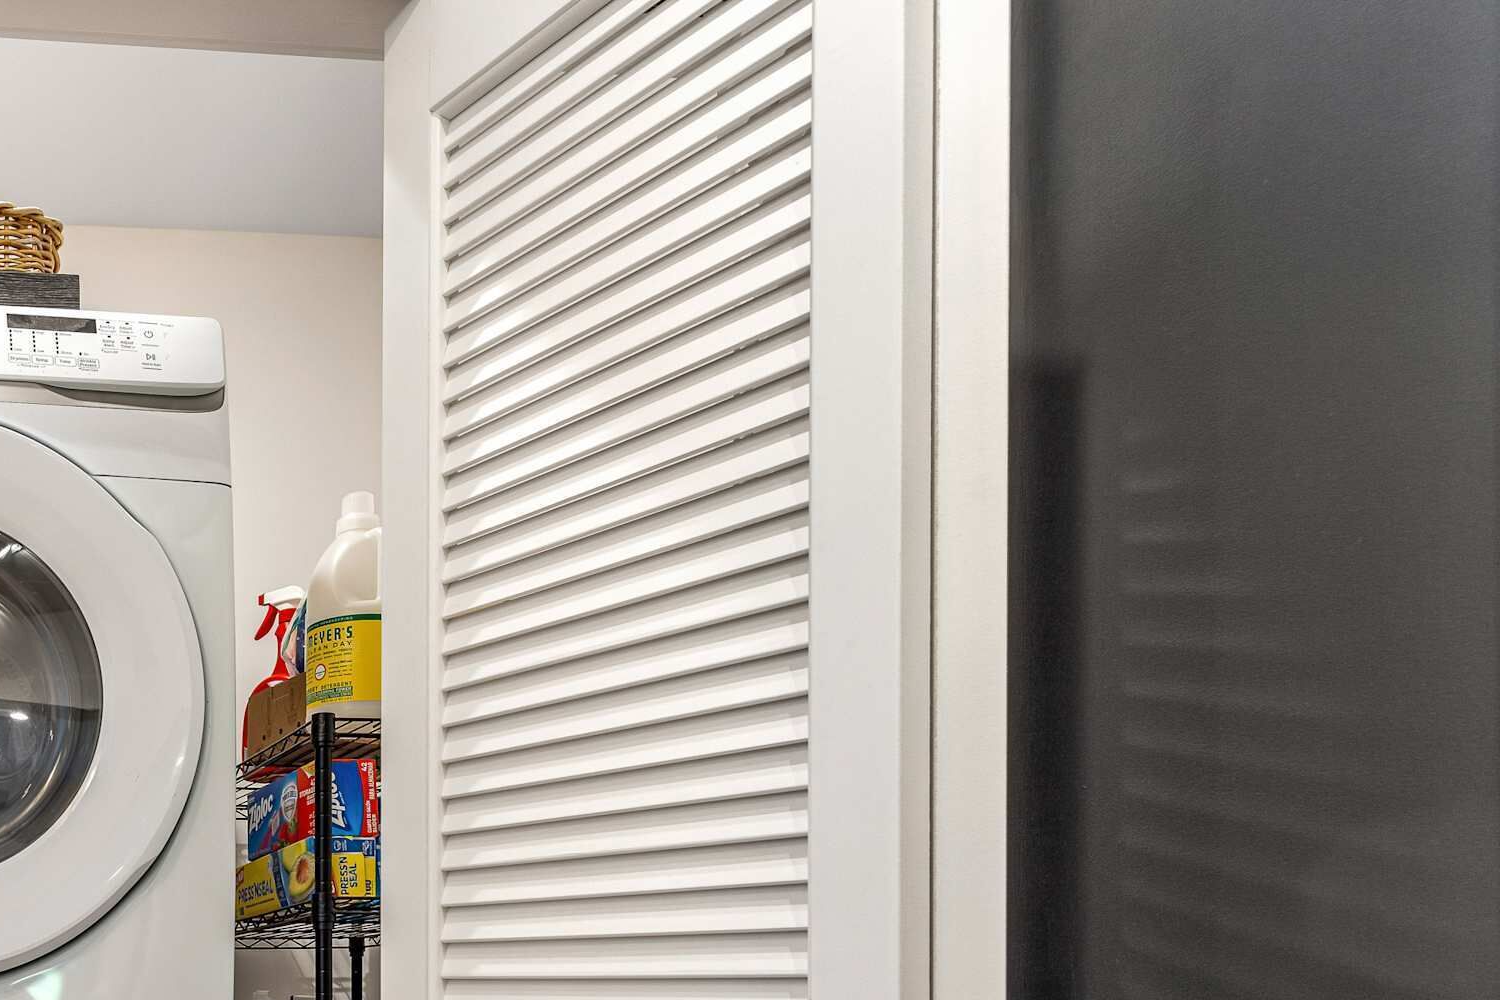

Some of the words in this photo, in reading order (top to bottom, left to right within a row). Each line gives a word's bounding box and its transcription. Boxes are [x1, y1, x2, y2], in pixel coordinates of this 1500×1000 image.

[333, 640, 352, 649] DAY
[249, 795, 274, 834] Ziploc
[349, 863, 358, 888] SEAL
